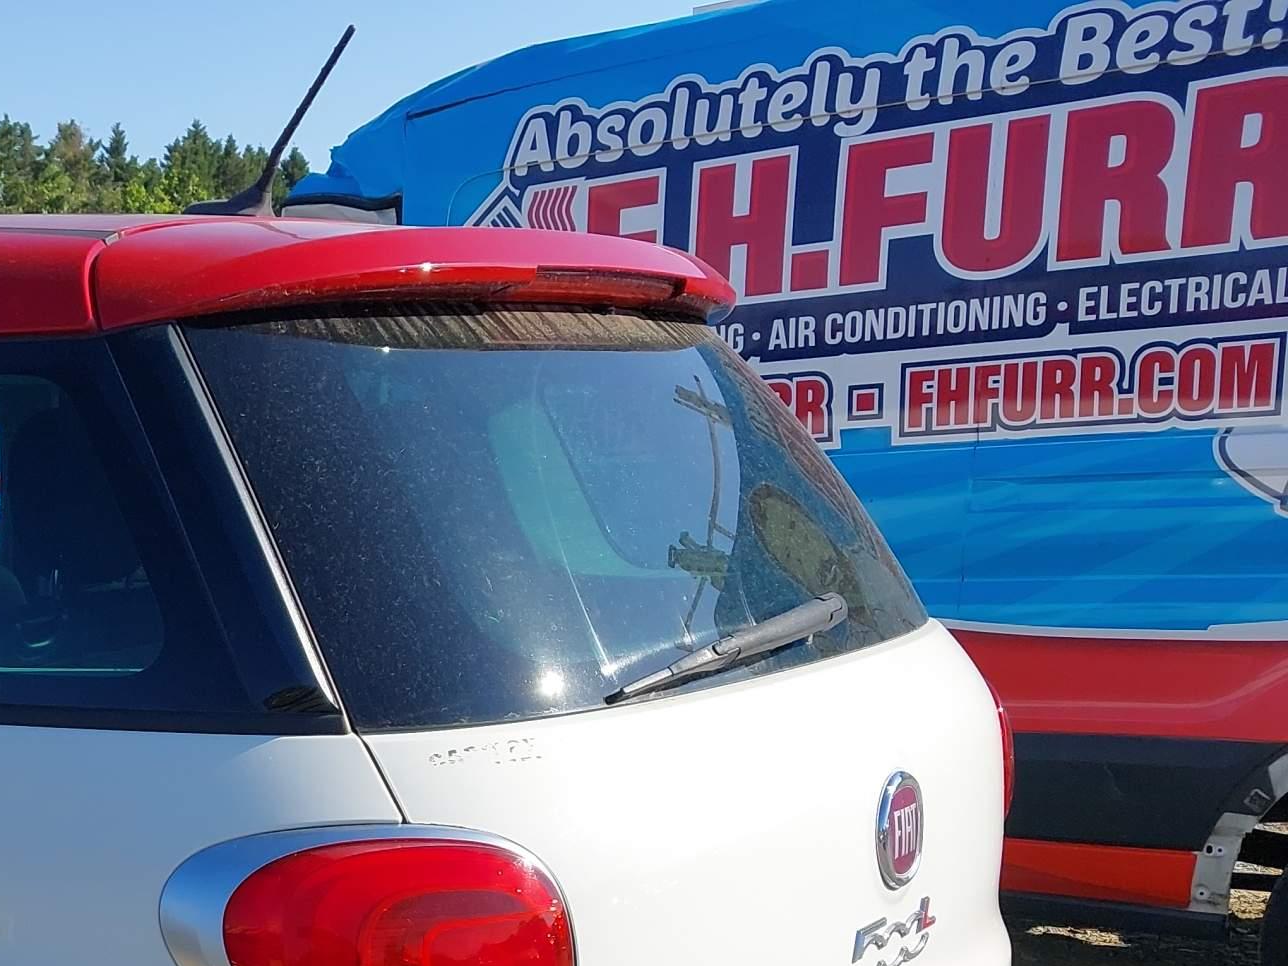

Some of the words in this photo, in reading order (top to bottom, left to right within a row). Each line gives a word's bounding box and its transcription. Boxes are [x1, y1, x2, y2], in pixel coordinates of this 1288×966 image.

[514, 60, 881, 177] Absolutely
[903, 37, 1037, 111] the
[1058, 0, 1288, 85] Best!
[587, 75, 1288, 297] FH.FURR
[768, 316, 816, 350] AIR
[824, 291, 1047, 345] CONDITIONING
[1077, 266, 1288, 322] ELECTRICAL
[906, 342, 1277, 429] FHFURR.COM
[893, 802, 917, 860] FIAT
